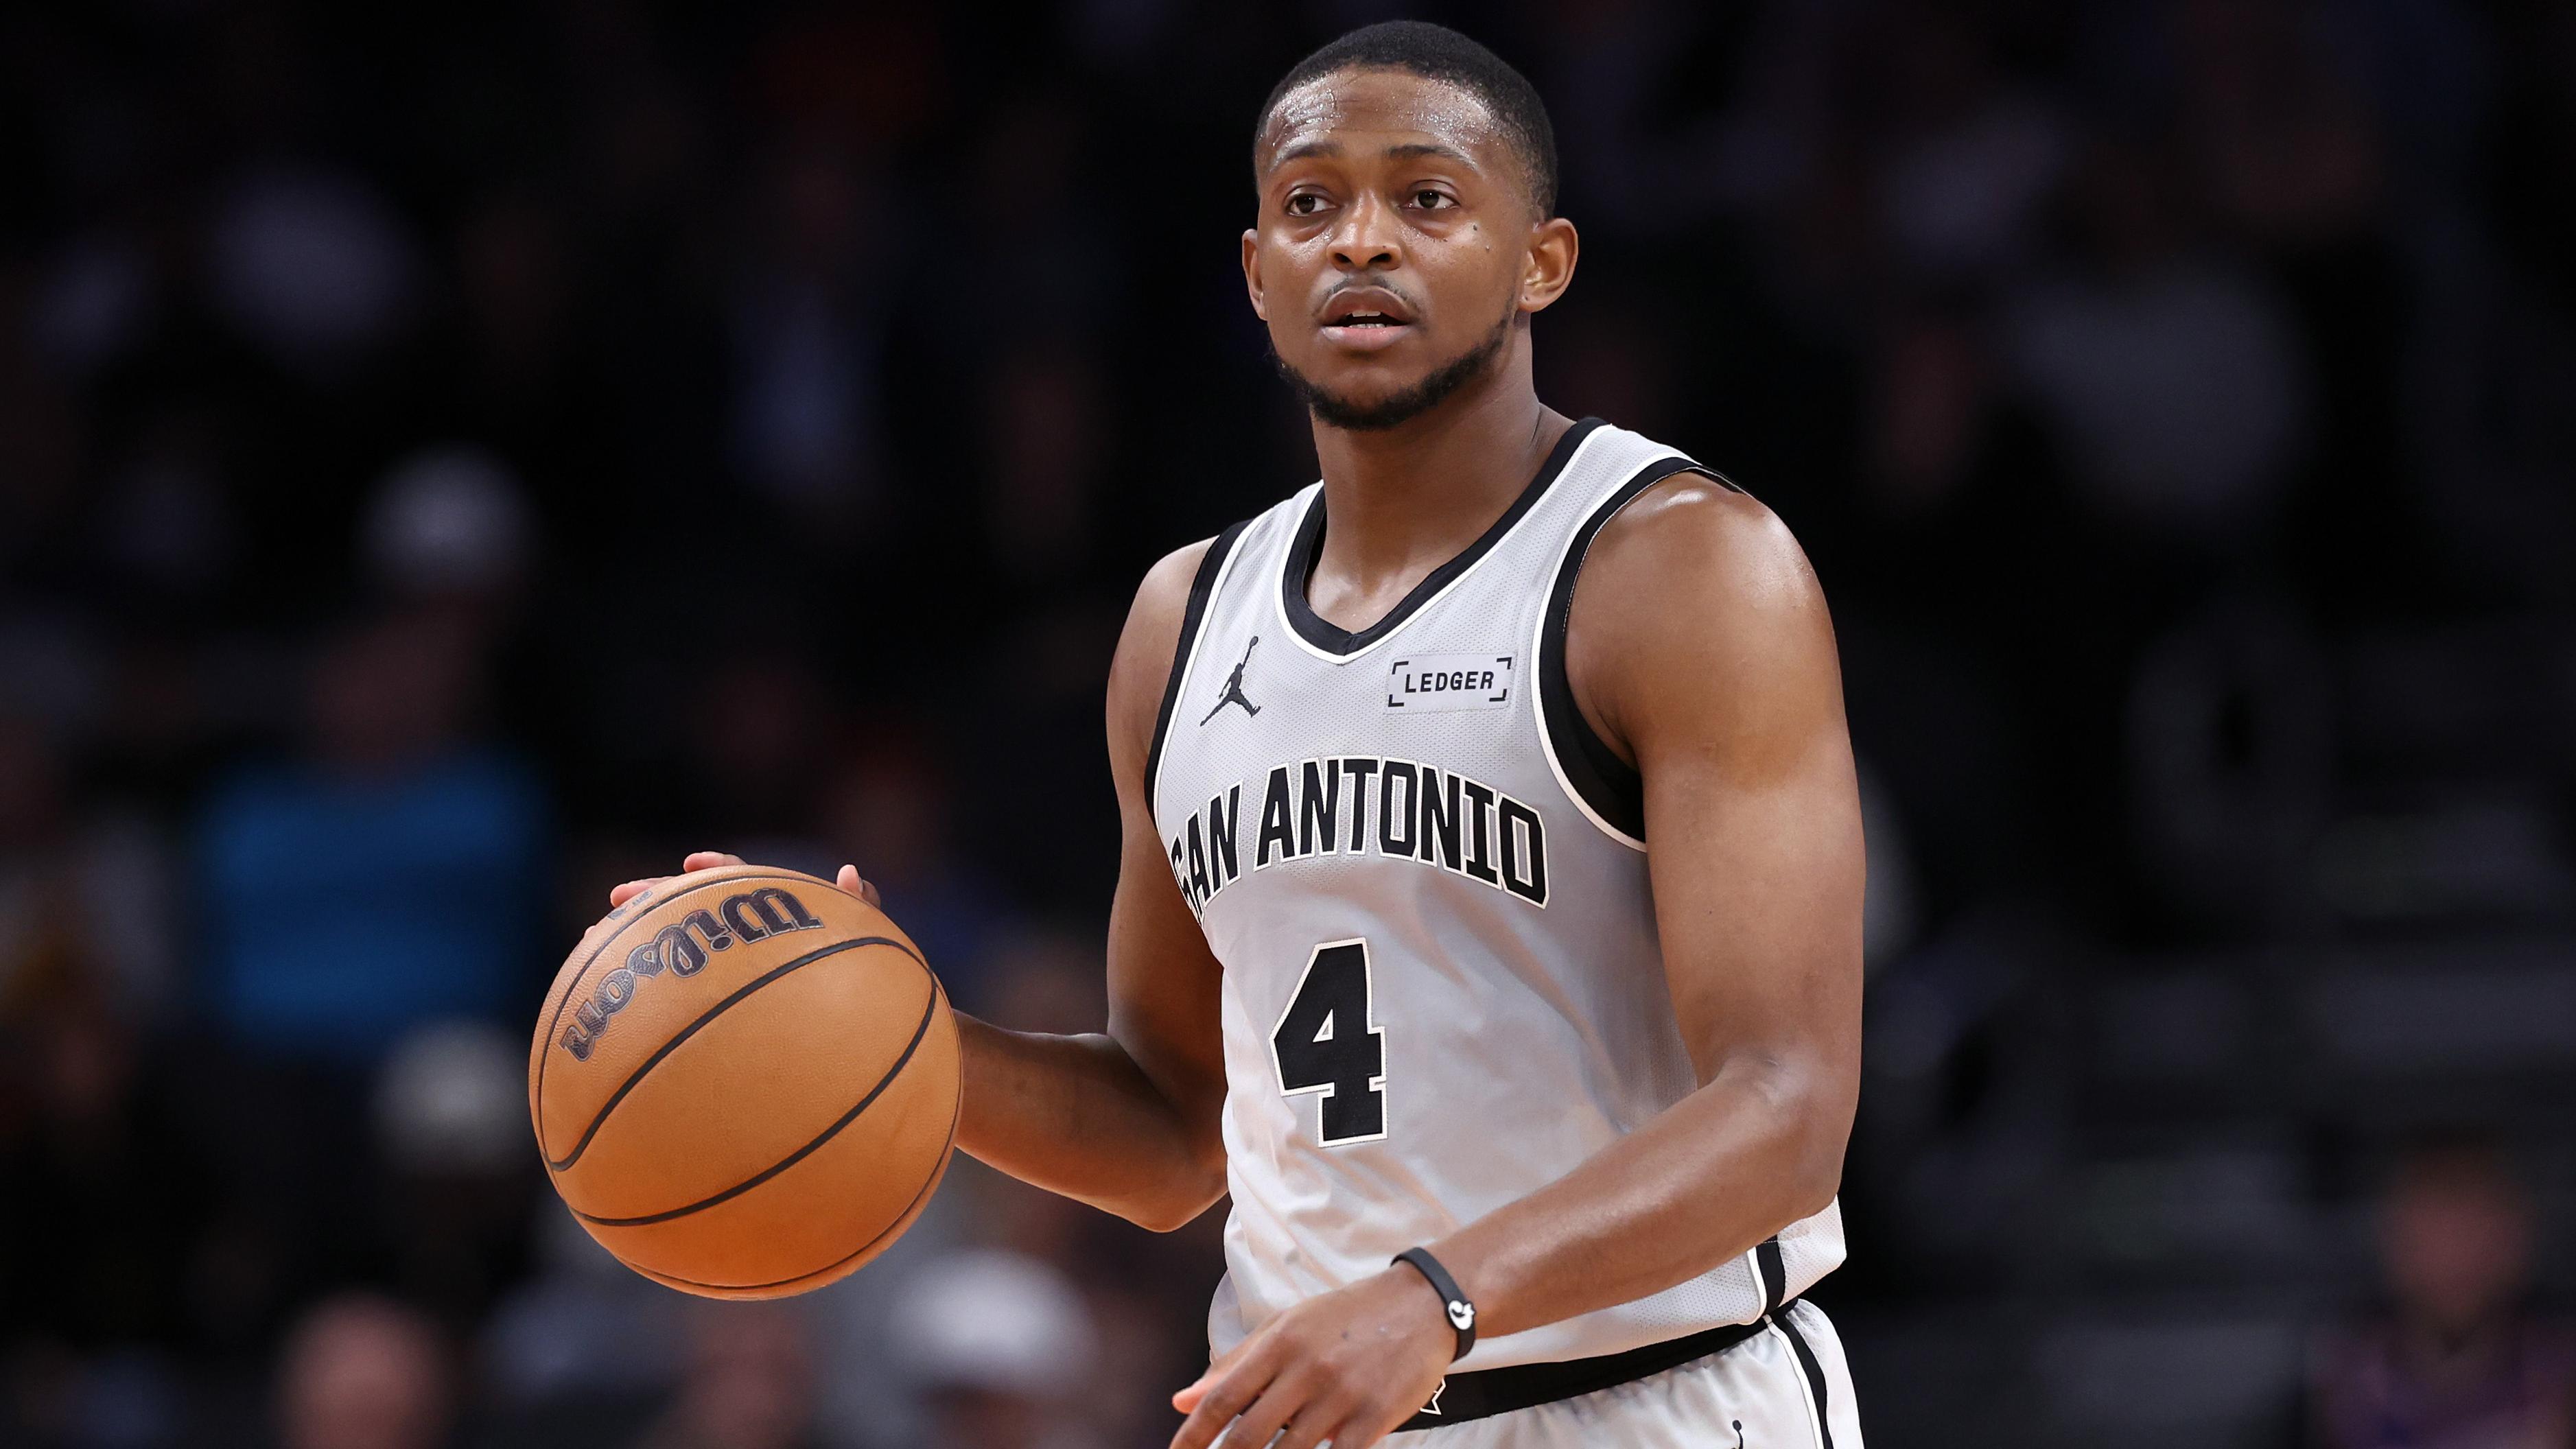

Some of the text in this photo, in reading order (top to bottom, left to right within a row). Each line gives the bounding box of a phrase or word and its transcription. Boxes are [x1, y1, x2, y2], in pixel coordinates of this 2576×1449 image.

[1405, 671, 1495, 693] LEDGER
[1253, 755, 1549, 909] ANTONIO
[559, 887, 825, 1062] Wilson
[1269, 936, 1387, 1148] 4
